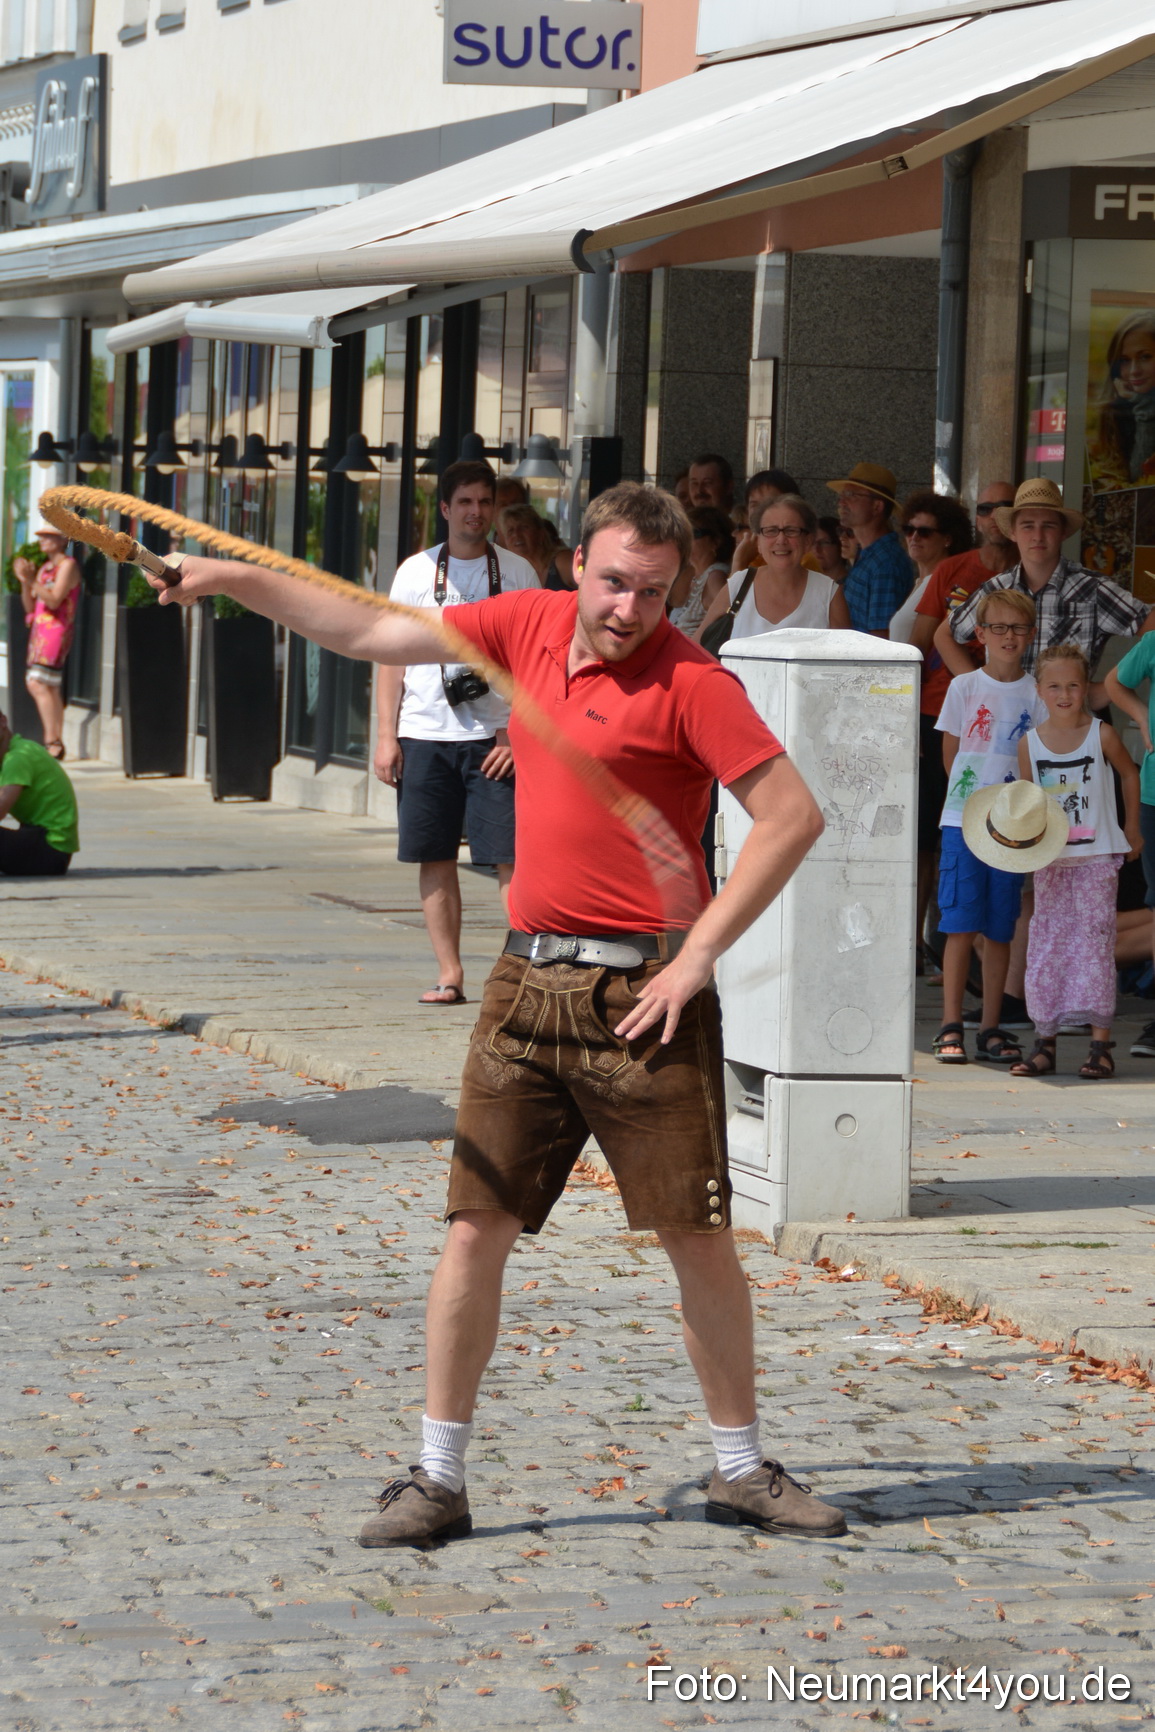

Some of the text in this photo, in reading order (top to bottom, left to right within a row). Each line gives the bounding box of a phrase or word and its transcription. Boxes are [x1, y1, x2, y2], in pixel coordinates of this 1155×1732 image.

[453, 15, 636, 71] sutor.
[437, 561, 446, 584] Canon
[490, 558, 498, 585] DIGITAL
[585, 708, 608, 725] Marc
